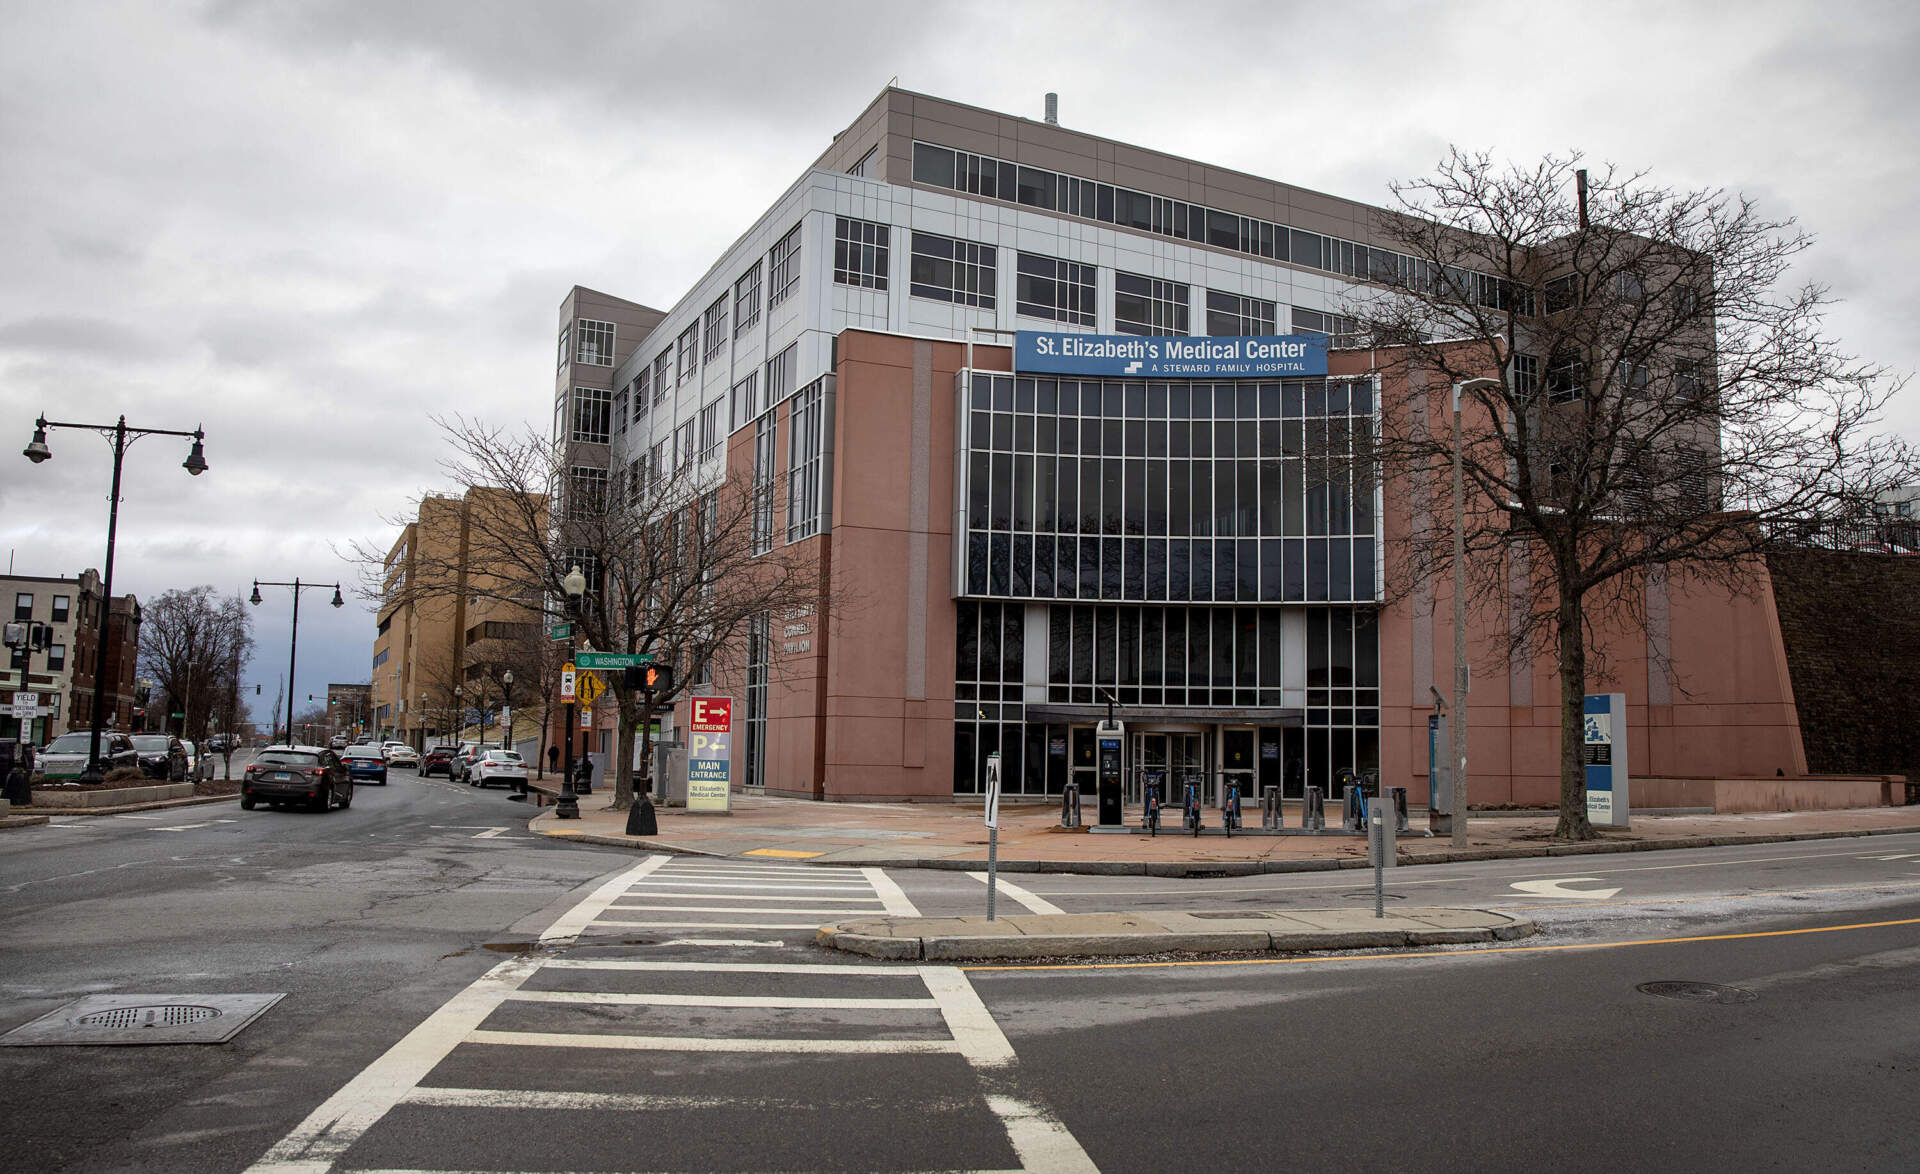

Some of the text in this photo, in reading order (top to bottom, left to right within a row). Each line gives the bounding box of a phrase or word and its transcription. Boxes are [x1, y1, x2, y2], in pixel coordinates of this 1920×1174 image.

[1036, 336, 1307, 360] St. Elizabeth's Medical Center
[1152, 363, 1306, 373] A STEWARD FAMILY HOSPITAL
[595, 658, 634, 667] WASHINGTON
[694, 700, 708, 723] E
[693, 734, 708, 756] P
[698, 761, 720, 770] MAIN
[691, 771, 727, 779] ENTRANCE
